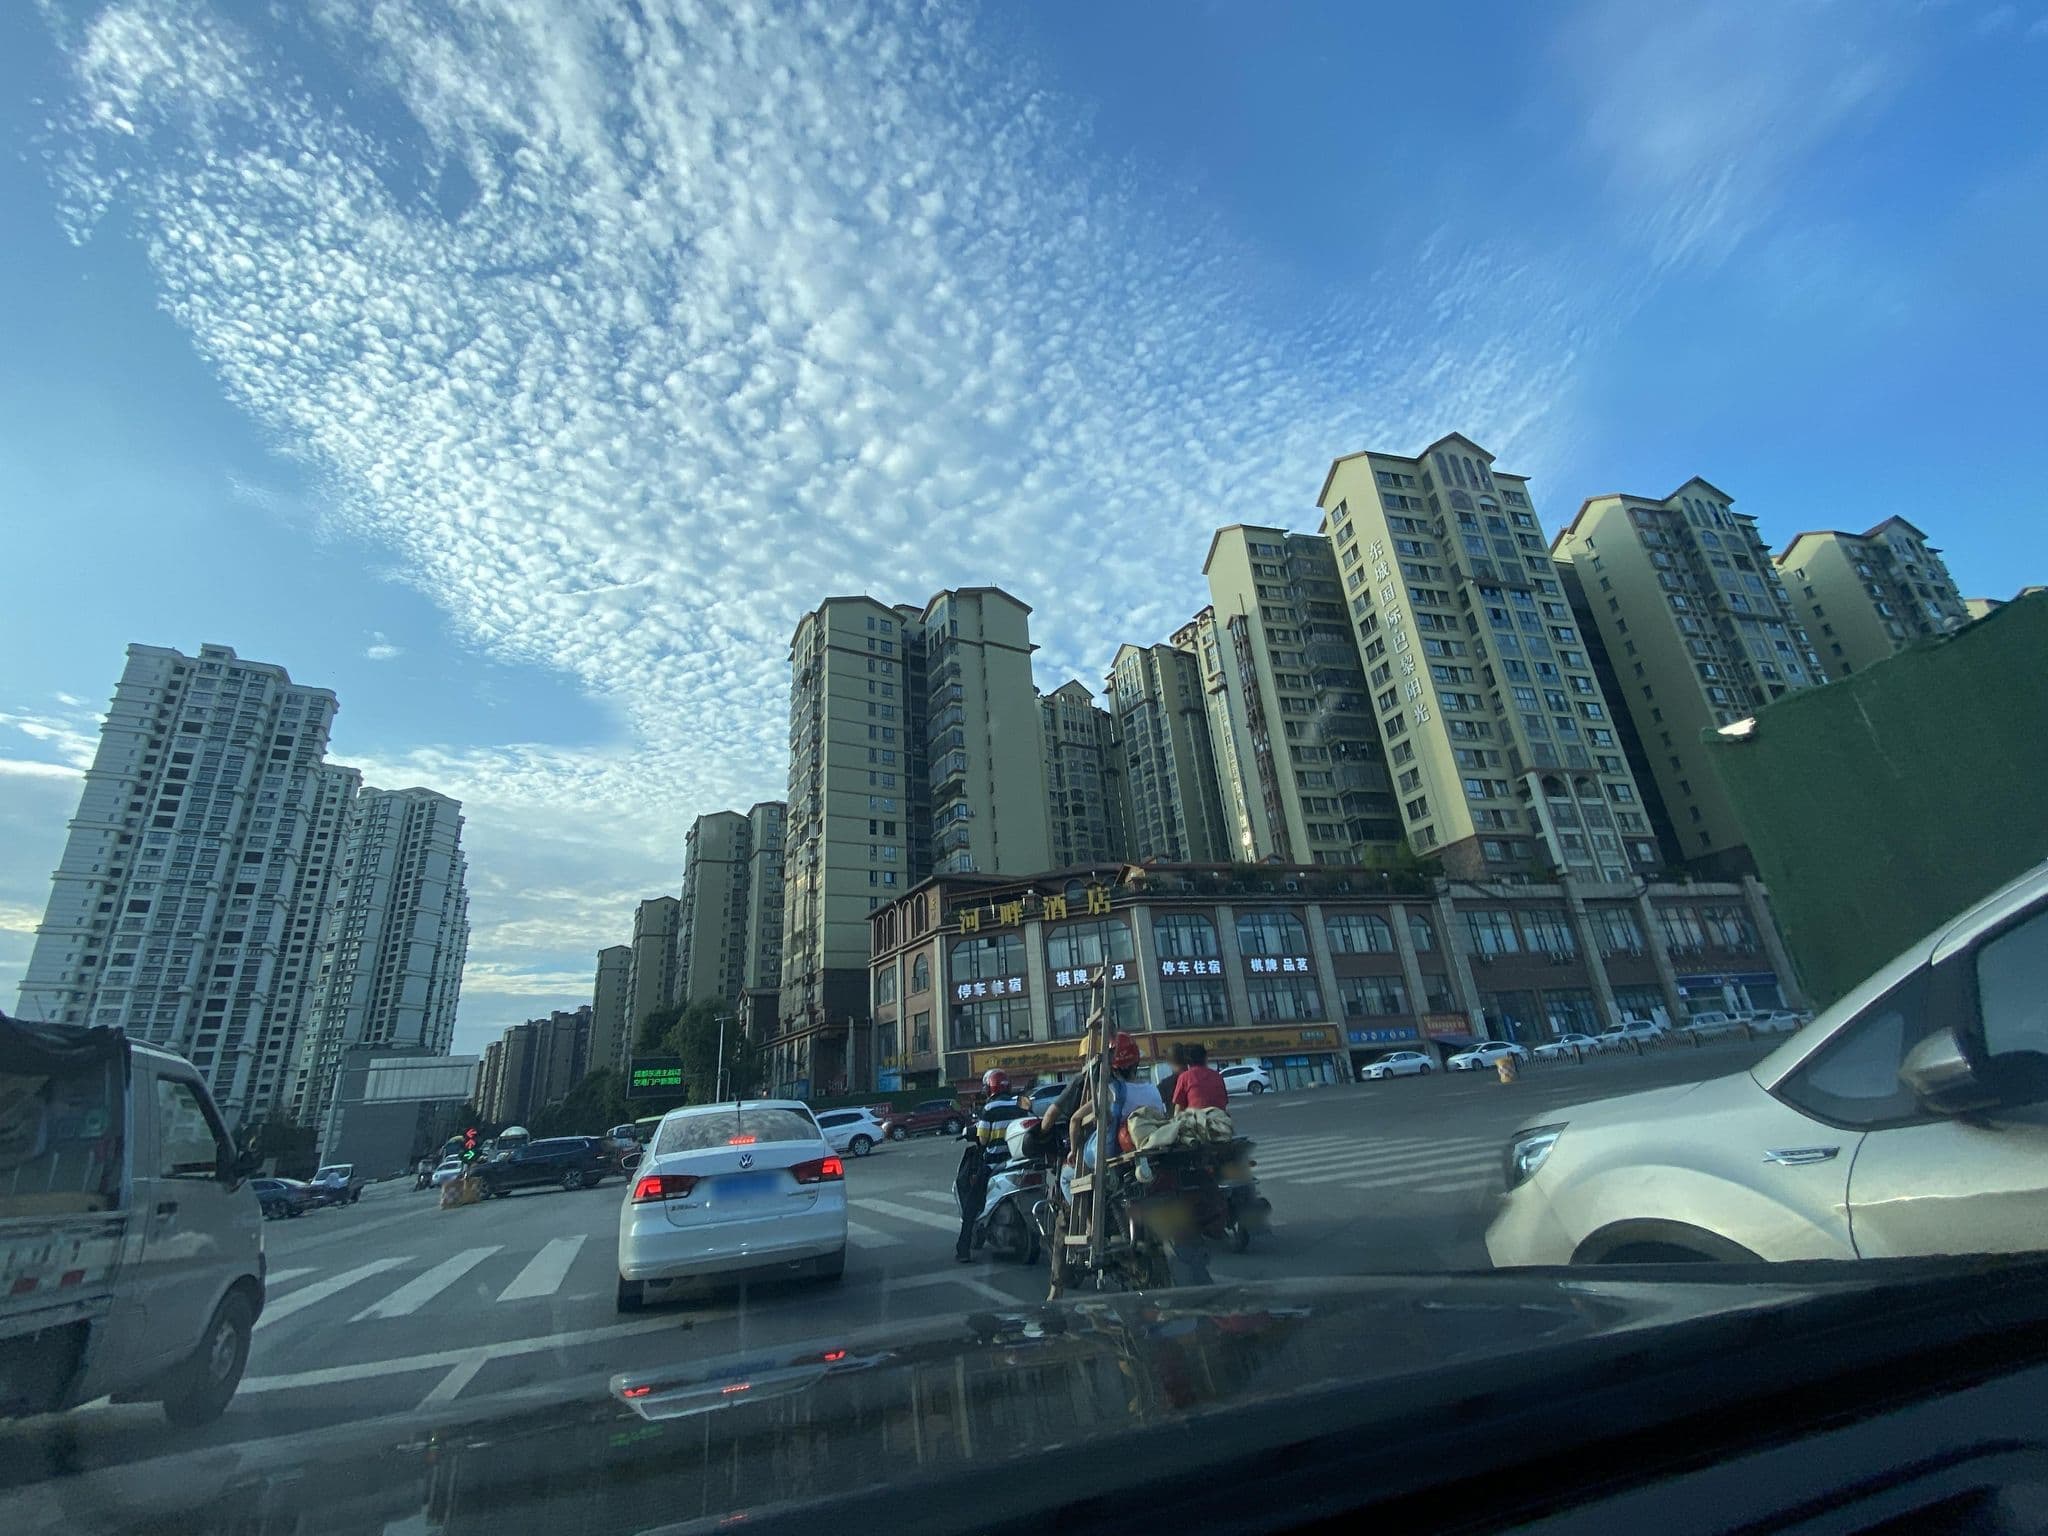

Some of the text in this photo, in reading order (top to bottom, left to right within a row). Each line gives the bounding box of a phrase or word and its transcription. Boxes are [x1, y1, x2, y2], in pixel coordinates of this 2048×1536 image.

[959, 886, 1111, 934] 河畔酒店
[1056, 963, 1126, 988] 棋牌锅
[1162, 960, 1221, 975] 停车住宿
[1250, 958, 1308, 972] 棋牌品茗
[957, 977, 1023, 1000] 停车住宿
